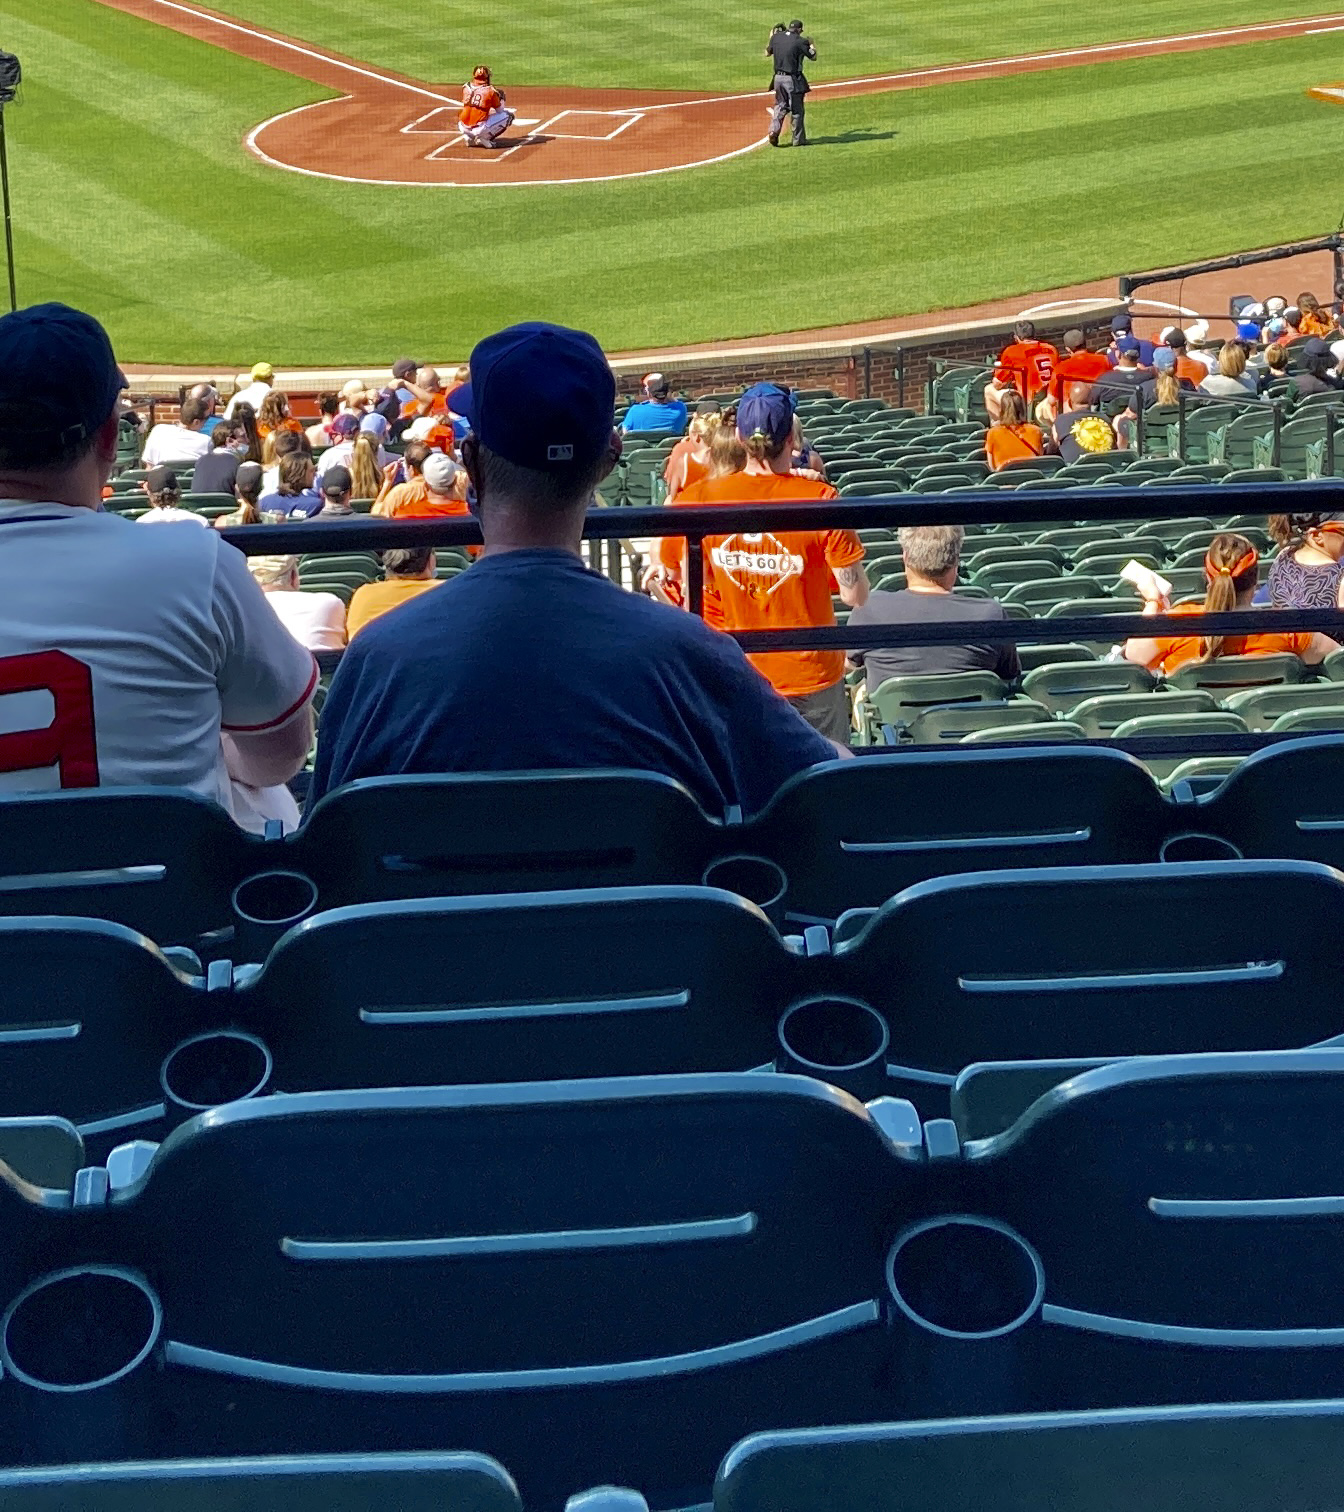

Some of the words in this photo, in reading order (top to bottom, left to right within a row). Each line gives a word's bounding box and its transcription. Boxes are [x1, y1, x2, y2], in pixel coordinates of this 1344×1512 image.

[1034, 354, 1054, 387] 5
[719, 553, 753, 567] LET'S
[757, 556, 777, 570] GO
